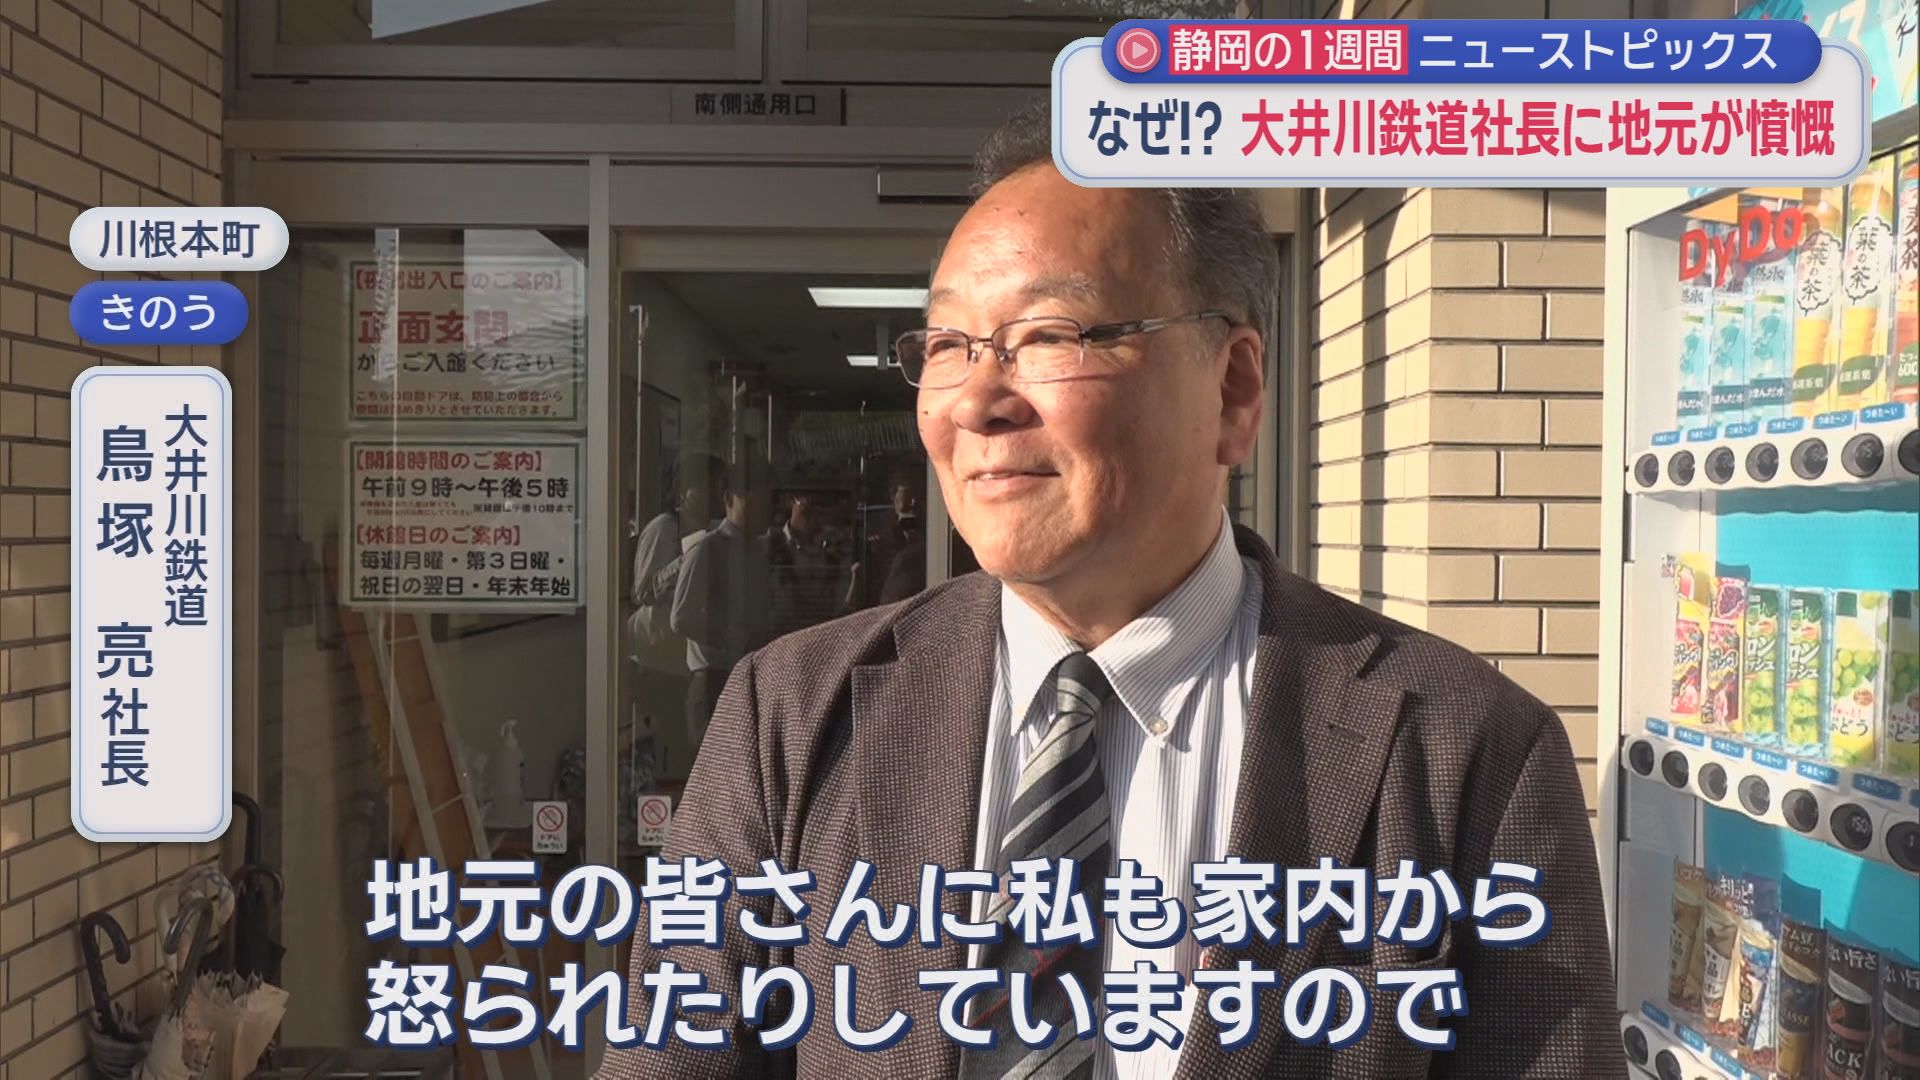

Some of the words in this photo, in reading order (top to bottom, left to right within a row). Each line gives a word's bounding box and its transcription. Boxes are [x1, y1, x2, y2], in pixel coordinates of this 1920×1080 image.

[695, 93, 816, 115] 南側通用口
[1678, 204, 1806, 288] DyDo
[357, 353, 555, 372] かご入館ください
[357, 450, 542, 471] 【開館時間のご案内】
[357, 525, 521, 546] 【休館日のご案内】
[360, 576, 570, 596] 祝日の翌日・年末年始
